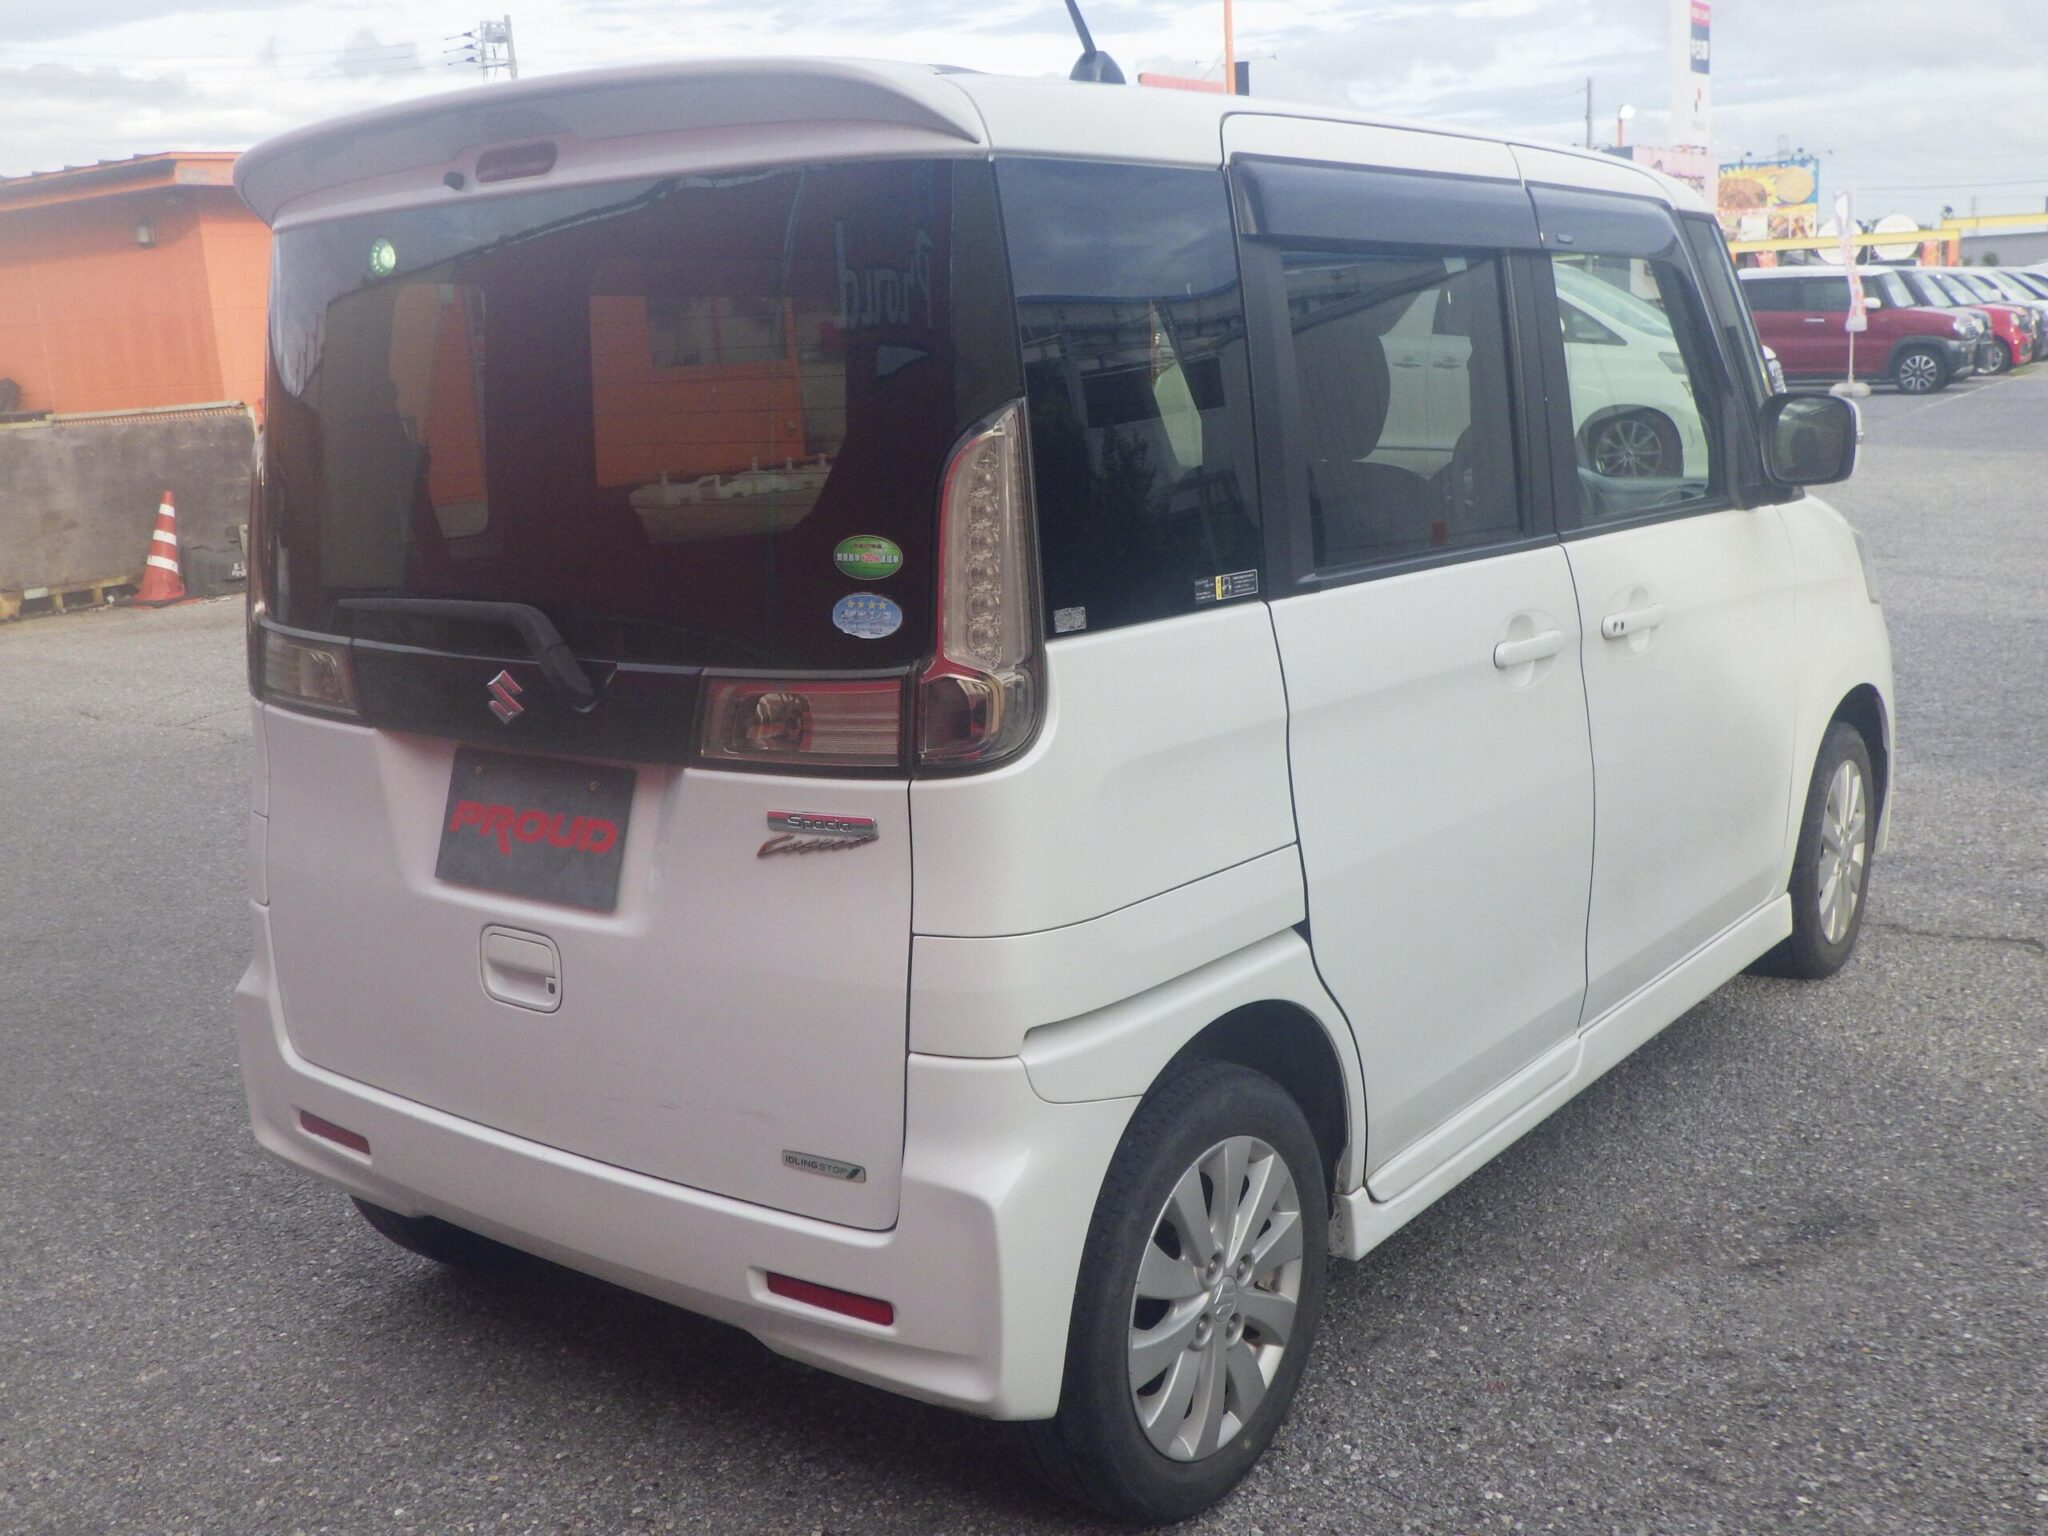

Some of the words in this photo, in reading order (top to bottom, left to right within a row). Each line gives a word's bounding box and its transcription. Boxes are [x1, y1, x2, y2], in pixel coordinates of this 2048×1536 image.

[450, 801, 618, 855] PROUD
[787, 815, 853, 833] Spacia
[785, 1155, 818, 1169] IDLING
[819, 1163, 848, 1175] STOP
